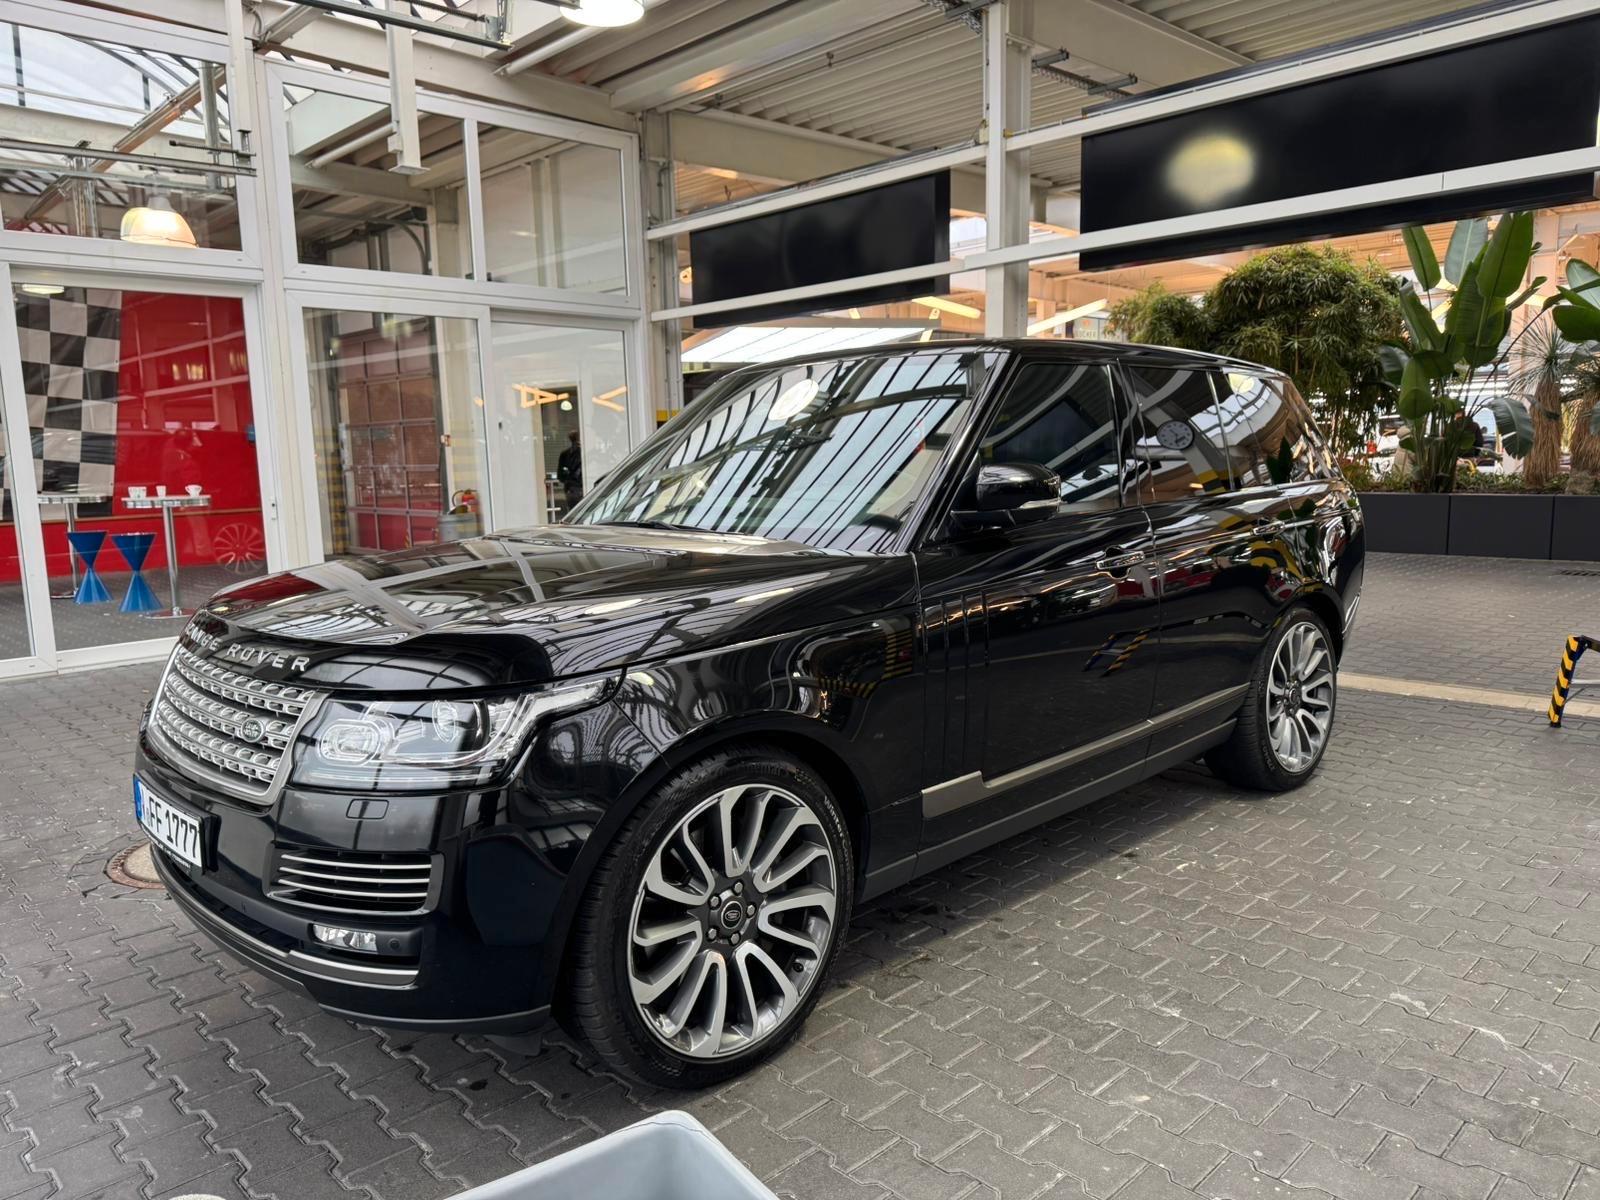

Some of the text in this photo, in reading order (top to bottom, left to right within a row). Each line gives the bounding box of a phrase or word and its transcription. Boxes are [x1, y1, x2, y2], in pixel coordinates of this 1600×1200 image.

[186, 622, 309, 671] ANGE ROVER
[165, 809, 198, 858] 1777
